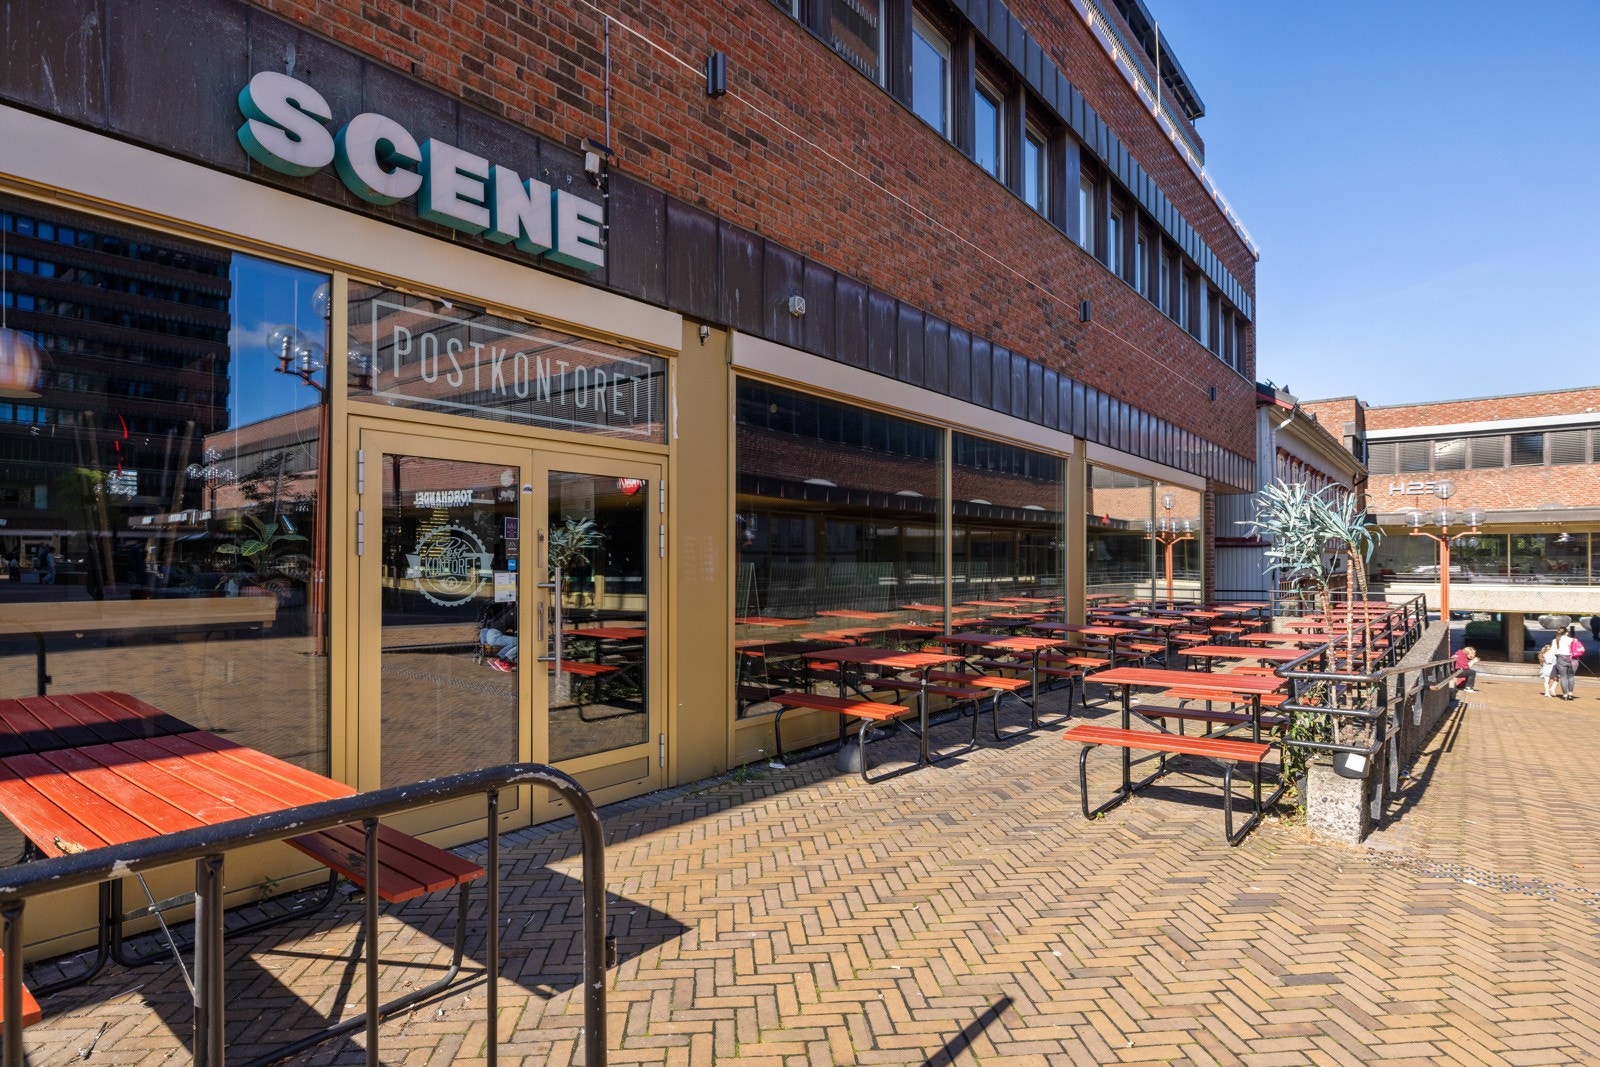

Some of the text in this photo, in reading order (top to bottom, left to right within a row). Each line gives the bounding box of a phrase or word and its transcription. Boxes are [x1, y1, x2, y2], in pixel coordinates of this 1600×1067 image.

[238, 71, 605, 272] SCENE
[393, 325, 641, 419] POSTKONTORET
[425, 556, 477, 577] KONTORET
[435, 537, 469, 558] Post
